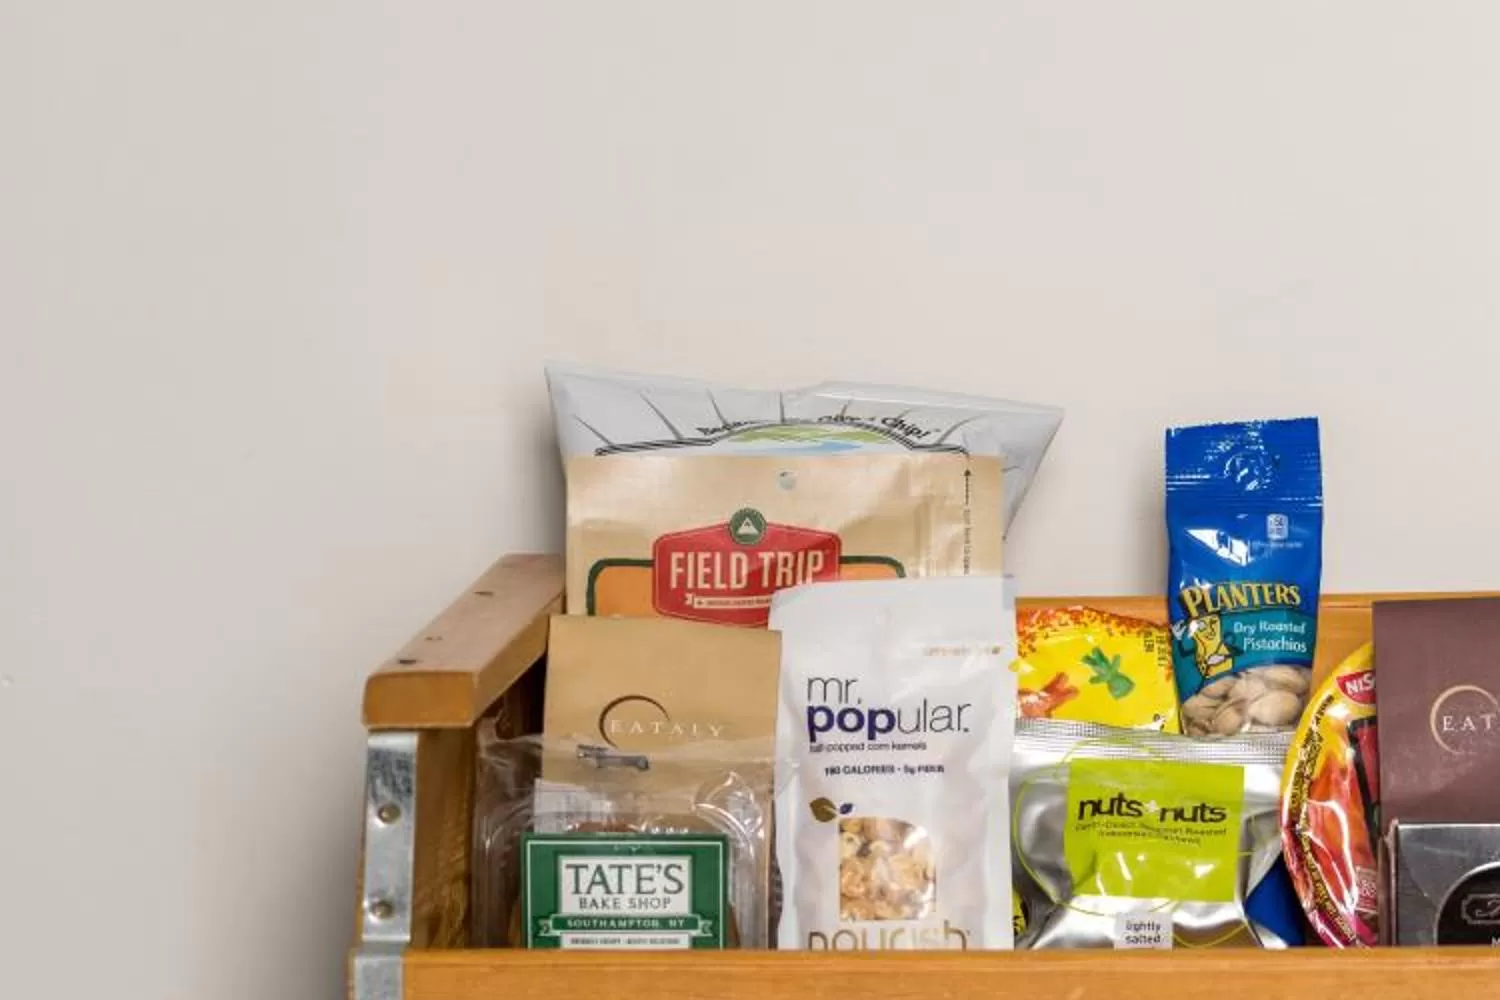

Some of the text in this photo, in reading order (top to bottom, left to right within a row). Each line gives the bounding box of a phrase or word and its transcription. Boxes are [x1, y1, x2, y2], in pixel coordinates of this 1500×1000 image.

[670, 549, 826, 590] FIELD TRIP
[1180, 583, 1302, 619] PLANTERS
[1233, 620, 1308, 636] Dry Roasted
[1243, 636, 1308, 653] Pistachios
[807, 677, 862, 704] mr.
[1345, 673, 1376, 696] NIS
[610, 719, 723, 737] EATALY
[807, 698, 972, 743] popular.
[1078, 792, 1228, 824] nuts nuts
[565, 863, 685, 895] TATE'S
[579, 897, 671, 910] BAKE SHOP
[1125, 920, 1161, 933] lightly
[1125, 933, 1161, 945] salted
